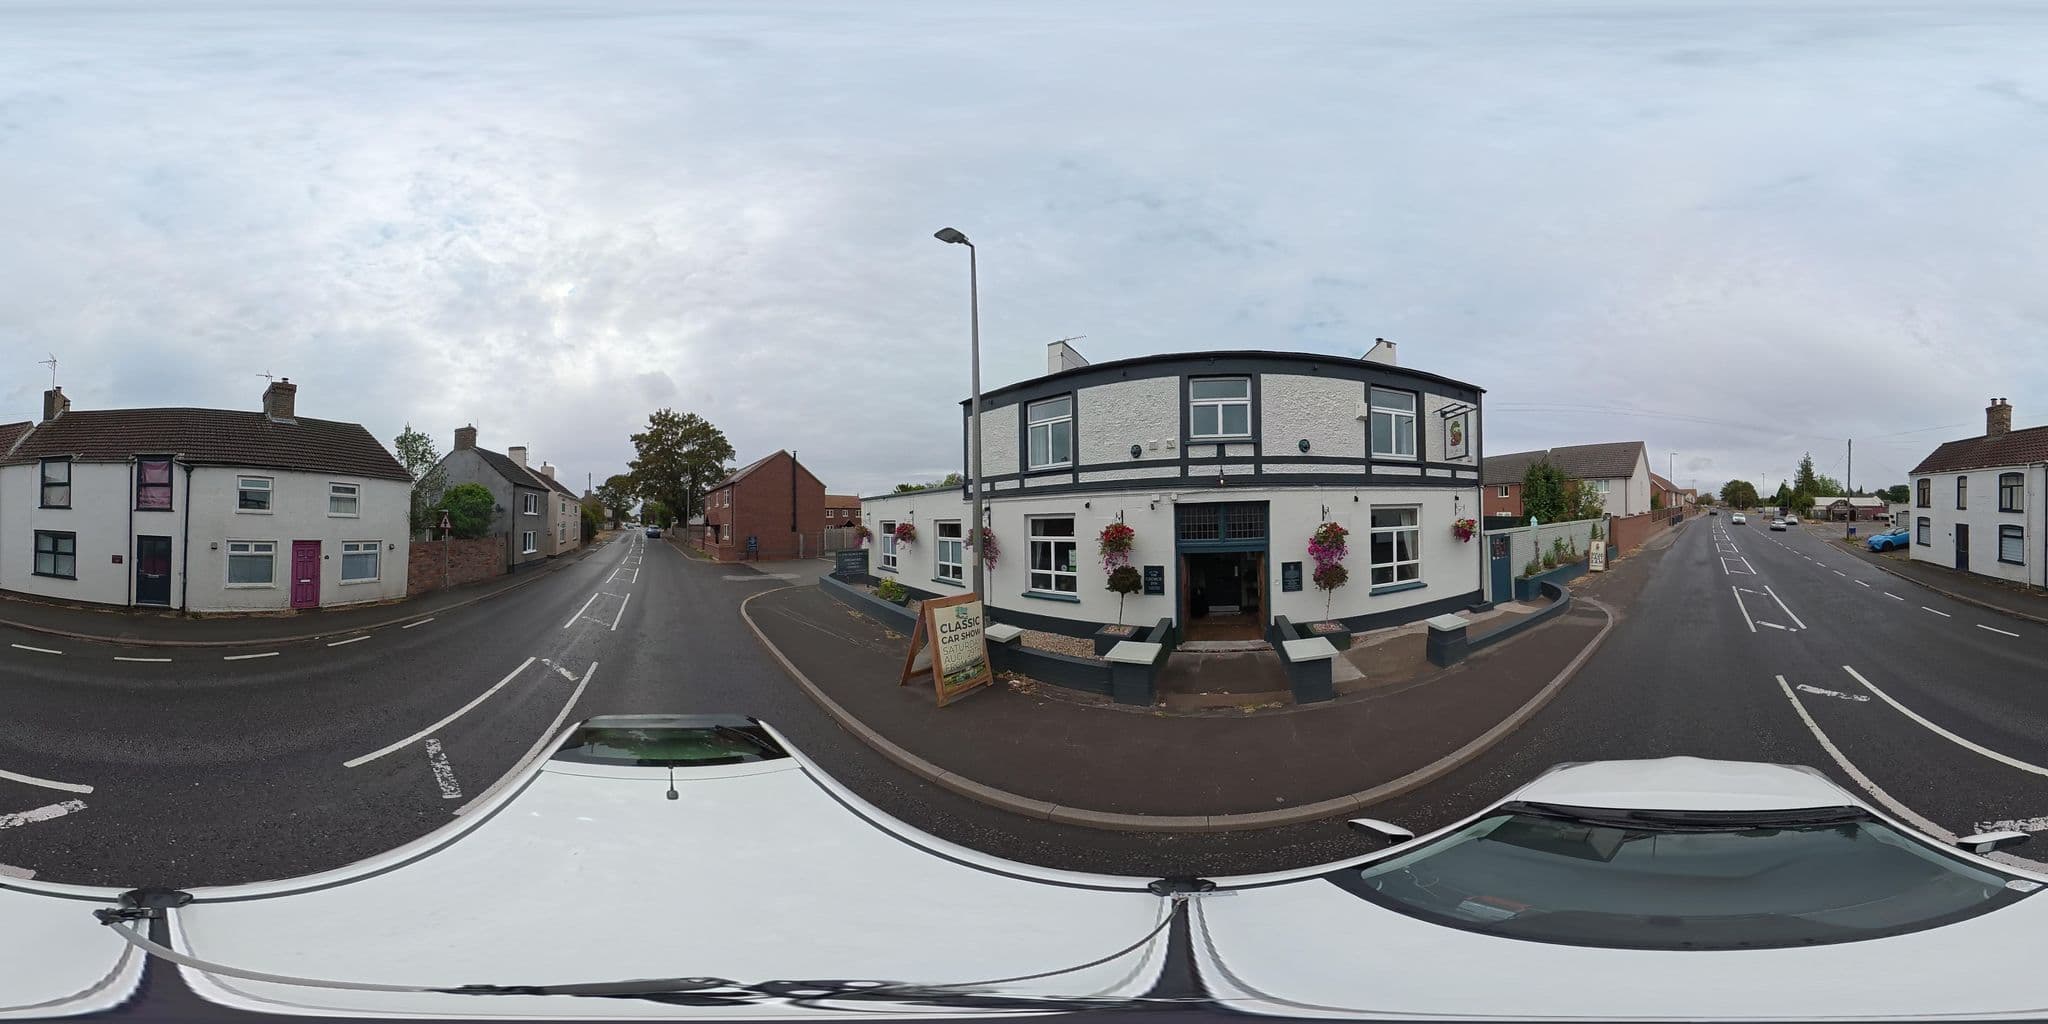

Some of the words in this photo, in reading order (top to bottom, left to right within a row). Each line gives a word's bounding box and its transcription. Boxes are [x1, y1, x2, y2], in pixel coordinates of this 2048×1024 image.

[940, 616, 980, 634] CLASSIC
[941, 634, 960, 645] CAR
[961, 628, 981, 640] SHOW
